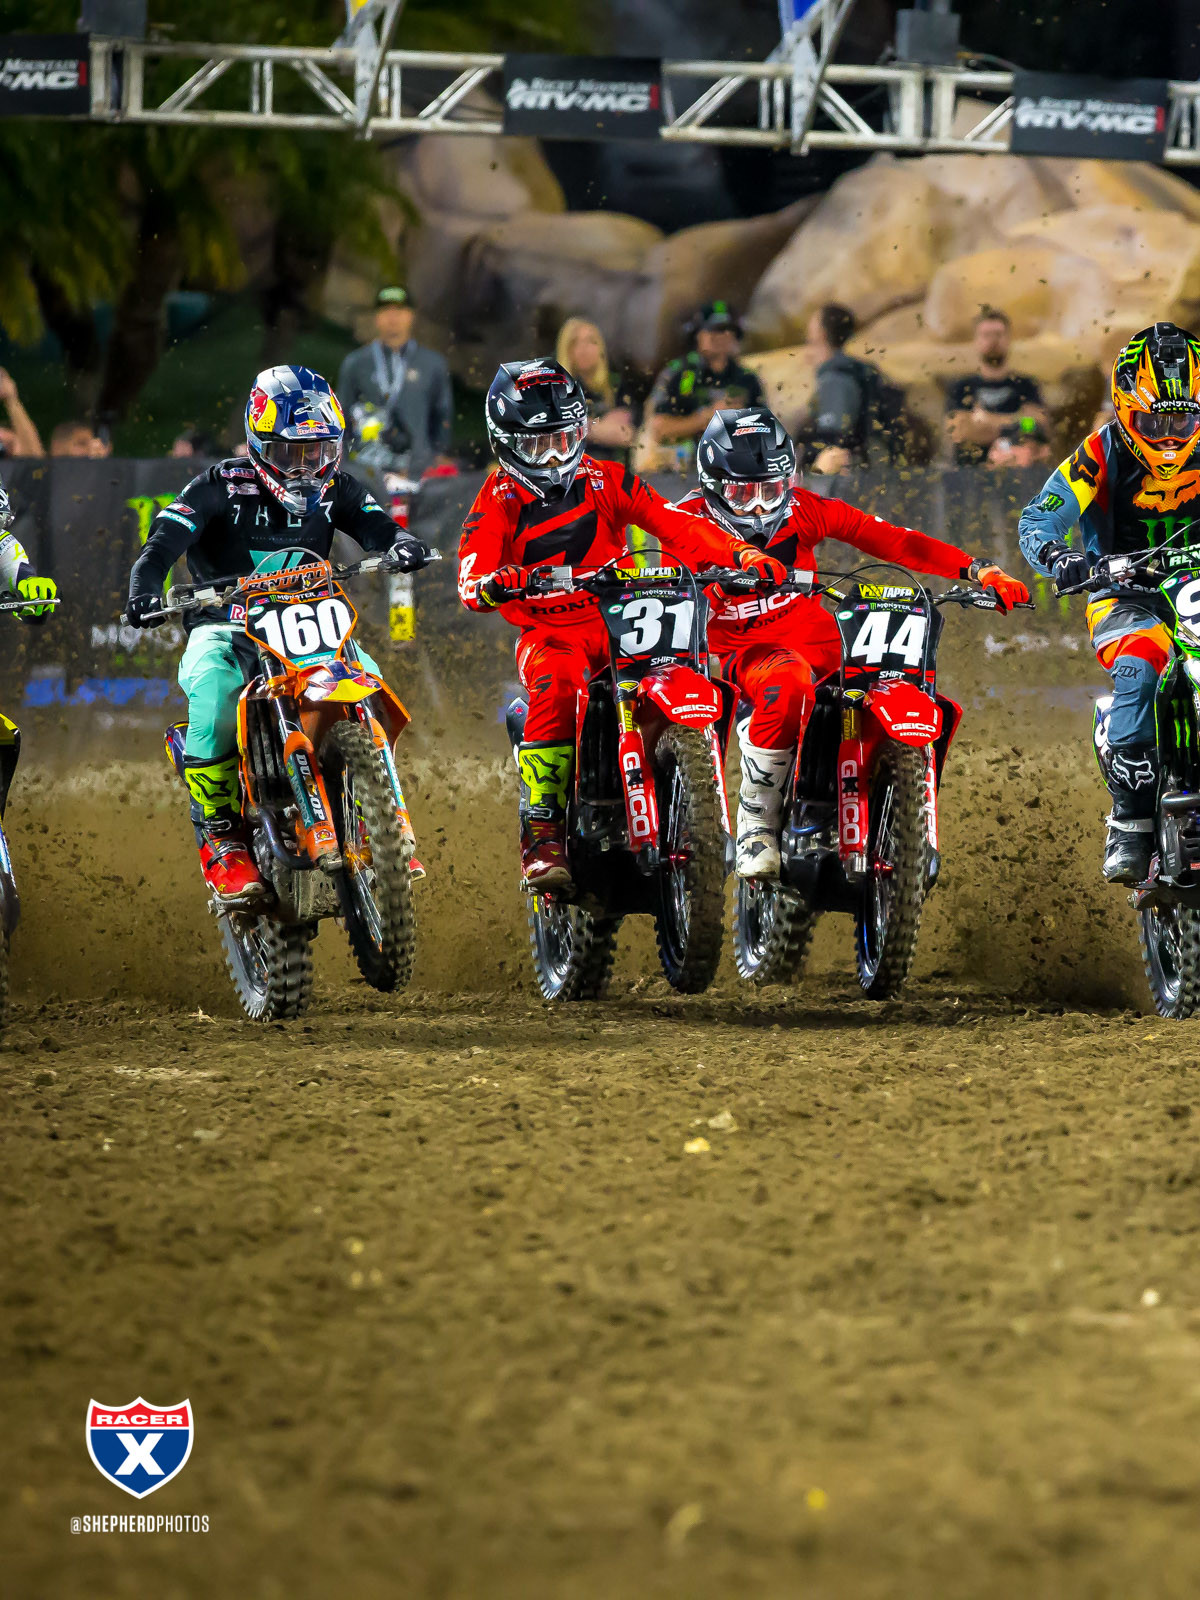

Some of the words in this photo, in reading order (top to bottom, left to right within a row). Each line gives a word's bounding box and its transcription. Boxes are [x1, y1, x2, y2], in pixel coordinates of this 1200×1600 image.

[1152, 400, 1200, 410] MONSTER
[276, 592, 316, 602] MONSTER
[254, 598, 352, 657] 160
[620, 598, 695, 657] 31
[851, 611, 928, 667] 44
[650, 656, 677, 665] SHIFT
[879, 671, 905, 679] SHIFT
[672, 705, 717, 714] GEICO
[892, 723, 936, 733] GEICO
